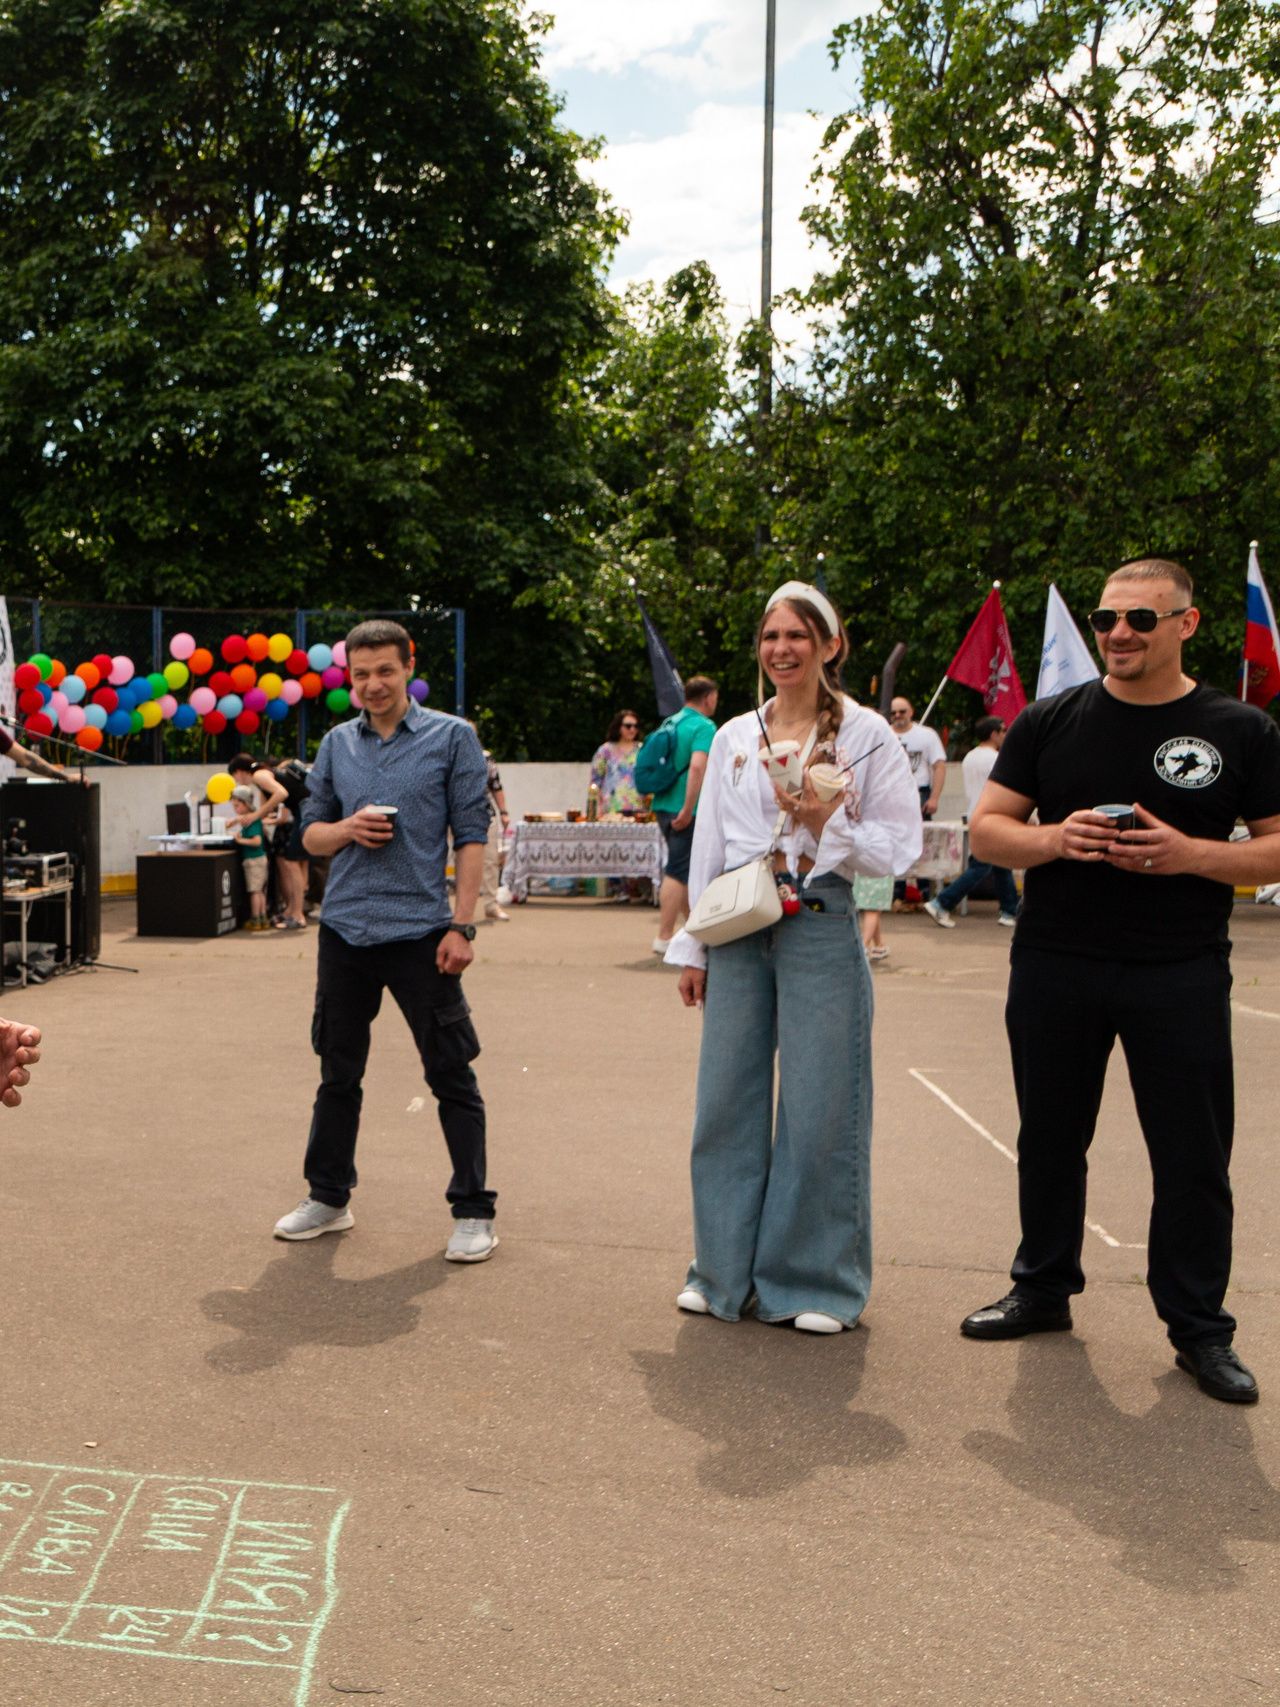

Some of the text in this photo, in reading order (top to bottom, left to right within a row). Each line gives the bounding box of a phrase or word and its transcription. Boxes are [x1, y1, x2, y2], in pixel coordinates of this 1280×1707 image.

[21, 1484, 116, 1575] СЛАВА
[99, 1486, 229, 1644] САША 24
[203, 1520, 313, 1653] ИМЯ ?
